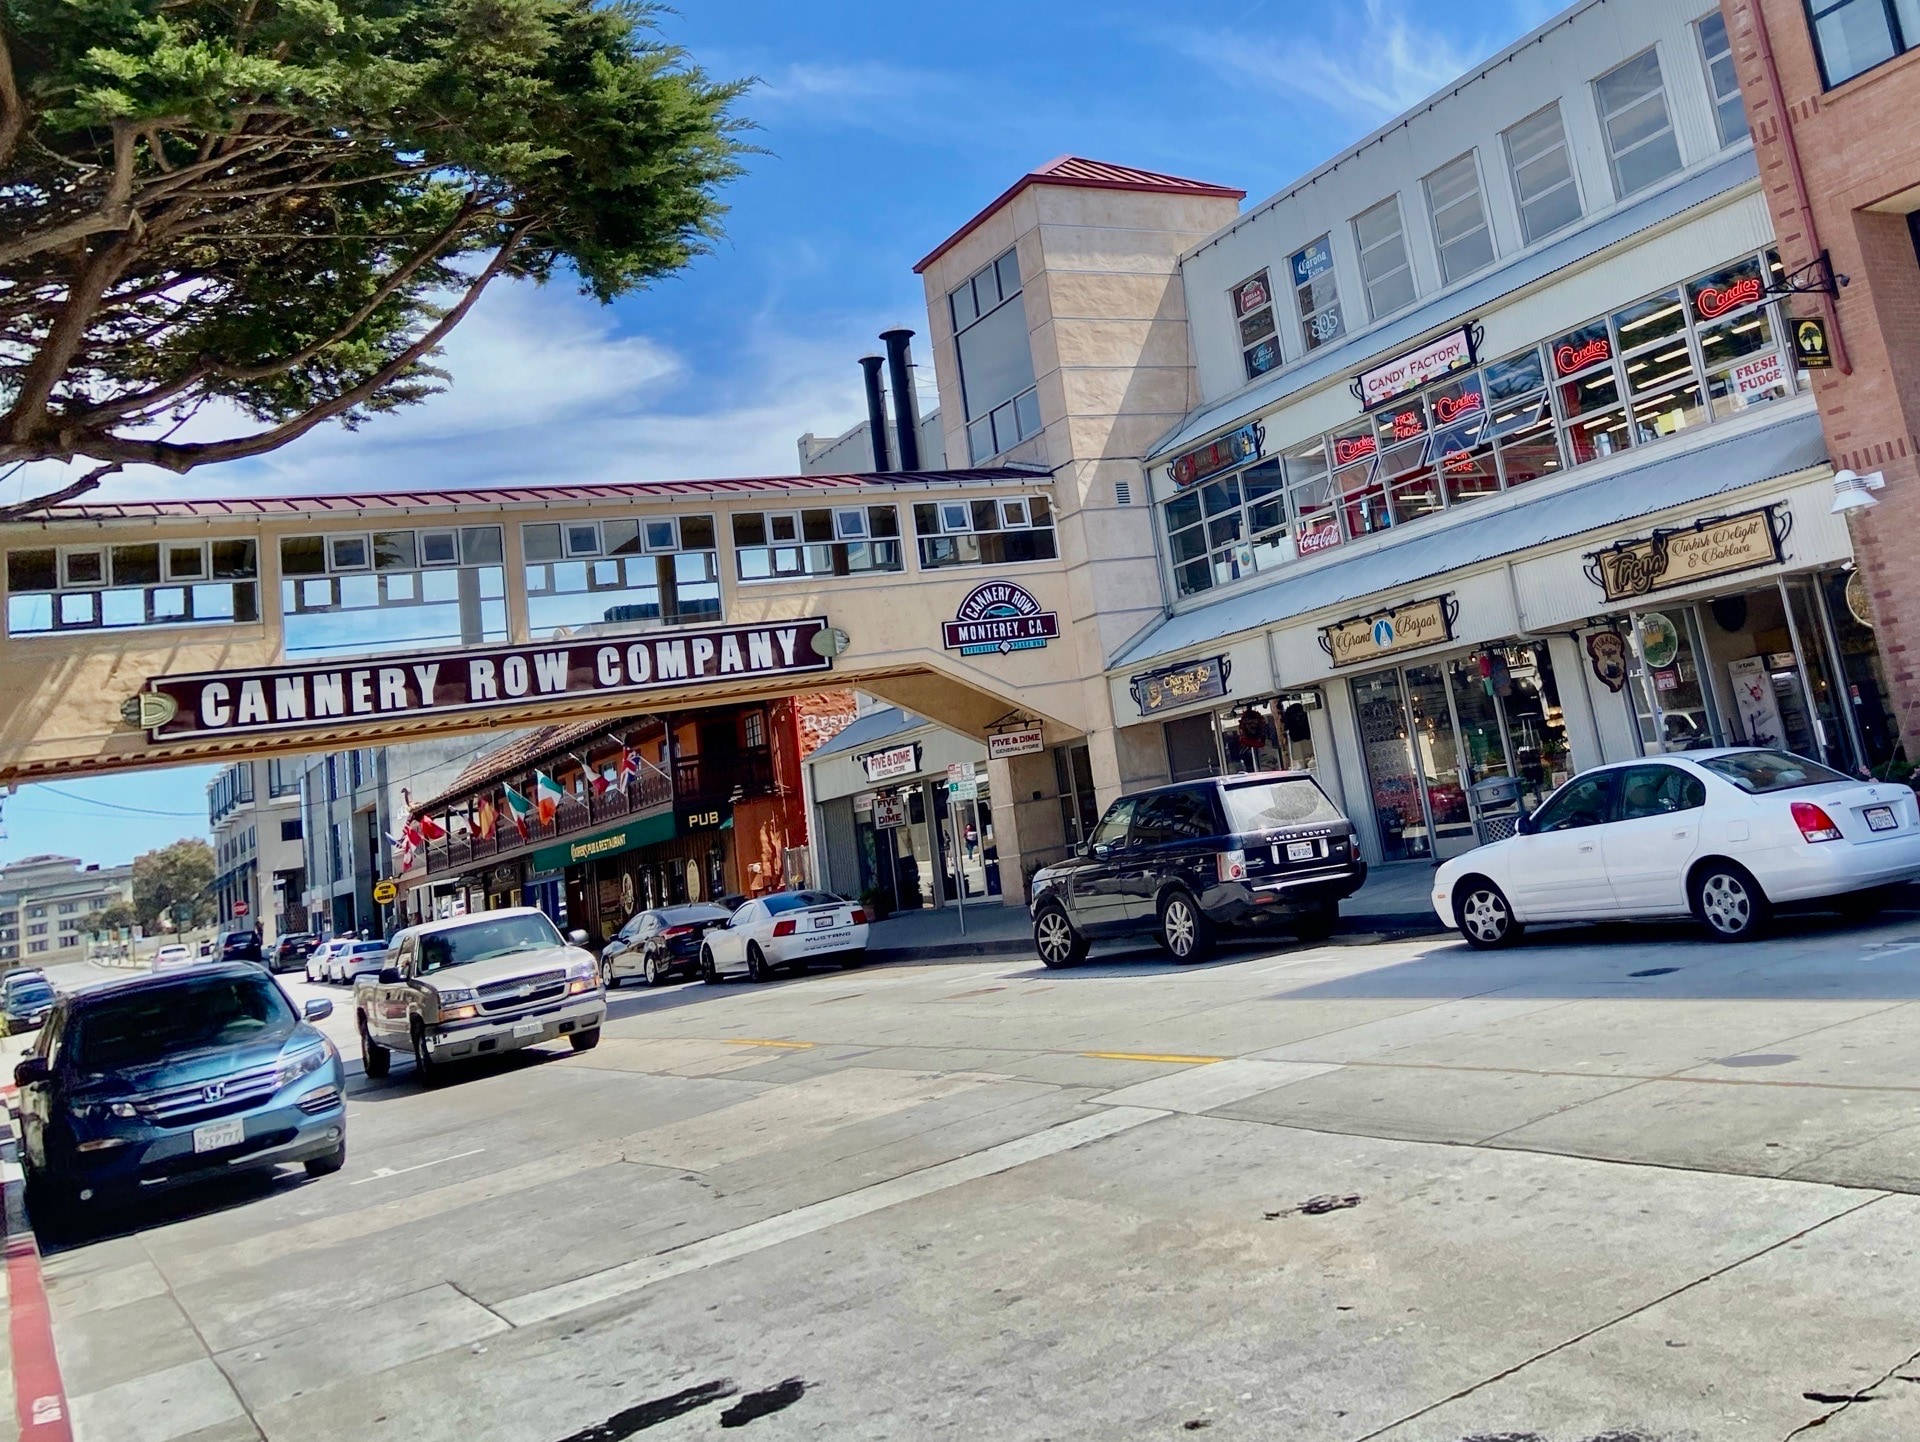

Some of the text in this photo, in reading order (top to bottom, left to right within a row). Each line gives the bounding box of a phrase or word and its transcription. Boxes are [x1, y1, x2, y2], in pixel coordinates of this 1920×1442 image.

[1298, 251, 1327, 275] Corona
[1698, 279, 1760, 318] Candies
[1311, 308, 1338, 337] 805
[1368, 343, 1460, 392] CANDY FACTORY
[1557, 340, 1608, 373] Candies
[1735, 355, 1778, 380] FRESH
[1740, 369, 1782, 392] FUDGE
[1395, 411, 1415, 426] FRESH
[1437, 392, 1481, 422] Candies
[1394, 422, 1423, 441] FUDGE
[1338, 435, 1376, 462] Candies
[1672, 521, 1760, 557] Turkish Delight
[1688, 555, 1699, 568] &
[1701, 544, 1751, 564] Baklava
[966, 585, 1035, 619] CANNERY ROW
[958, 619, 1048, 641] MONTEREY, CA.
[1335, 614, 1437, 655] Grand Bazaar
[201, 629, 797, 727] CANNERY ROW COMPANY
[992, 738, 1011, 747] FIVE
[1019, 733, 1040, 743] DIME
[871, 749, 911, 771] FIVE & DIME
[877, 798, 899, 809] FIVE
[689, 811, 719, 828] PUB
[879, 813, 902, 824] DIME
[805, 931, 851, 942] MUSTANG
